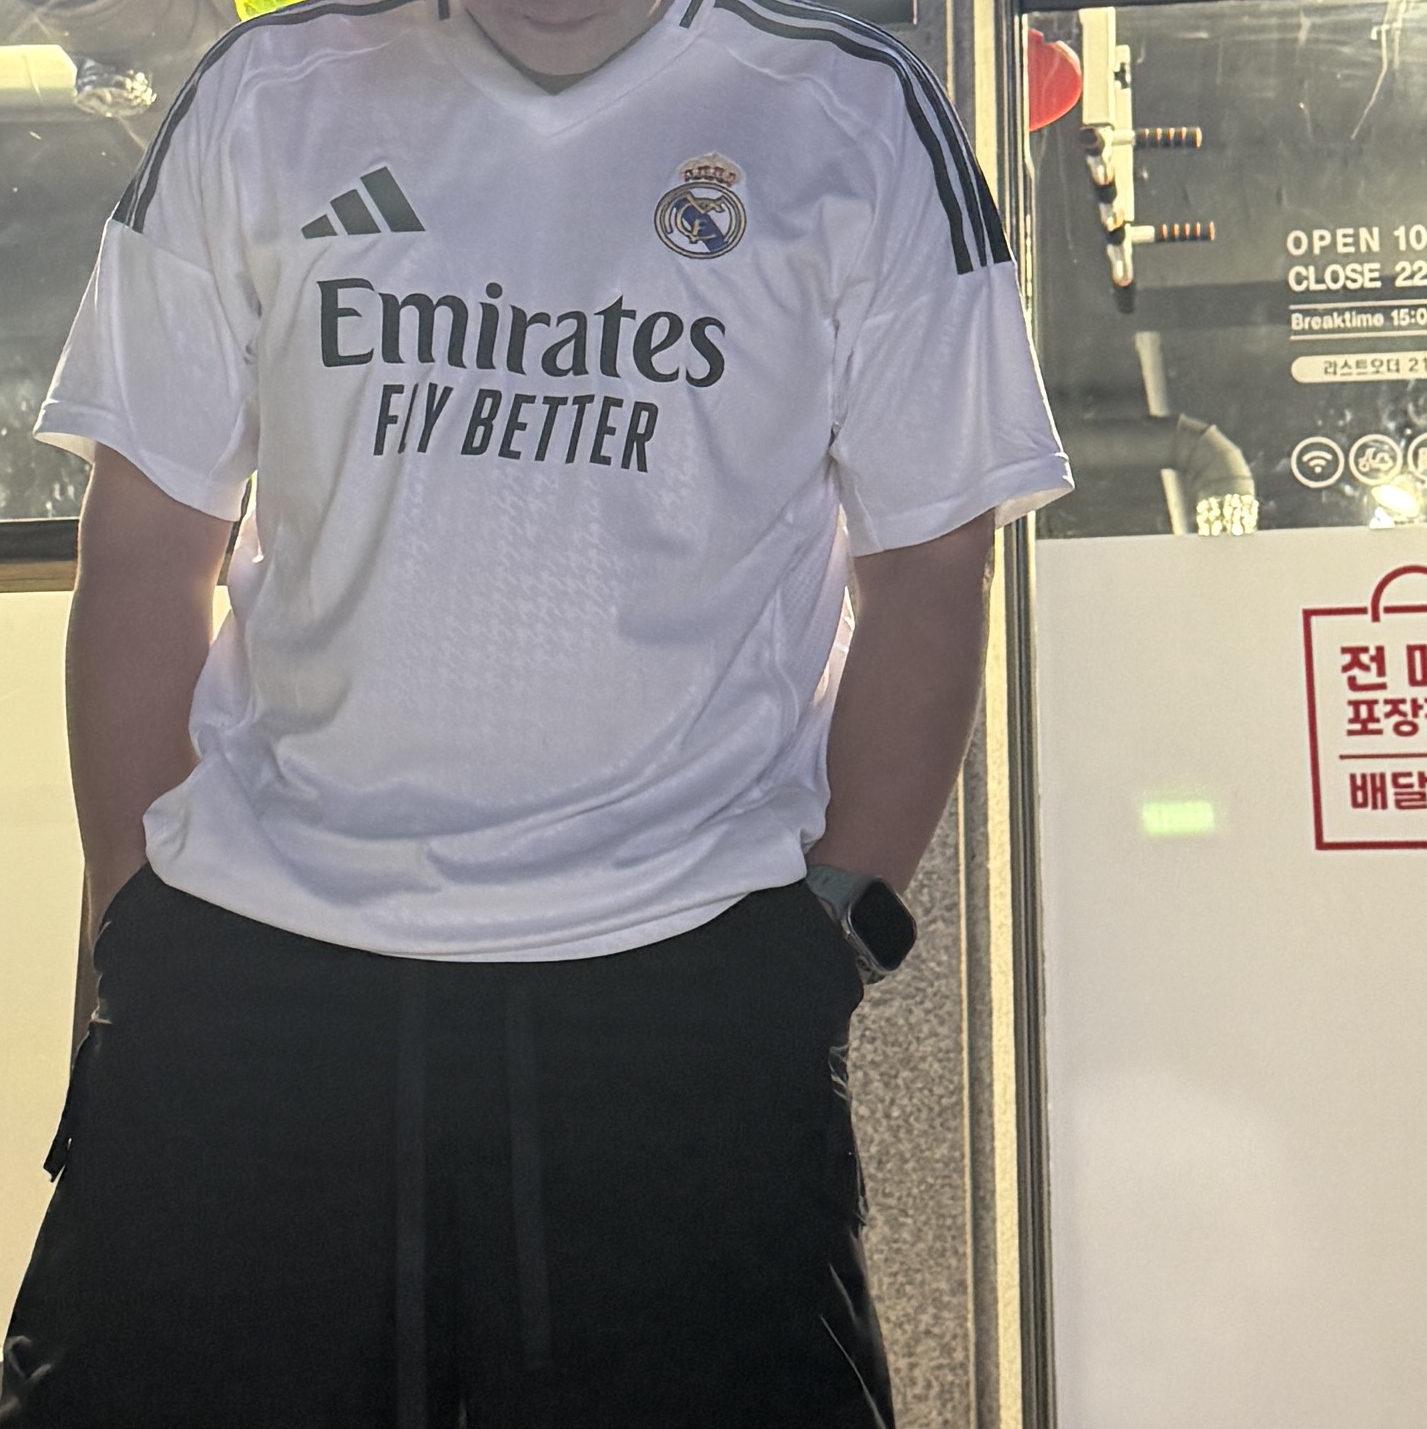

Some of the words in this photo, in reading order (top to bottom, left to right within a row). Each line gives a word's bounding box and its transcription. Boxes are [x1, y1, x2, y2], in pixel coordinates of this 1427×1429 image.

[1286, 226, 1381, 257] OPEN
[1287, 262, 1382, 292] CLOSE
[316, 277, 727, 388] Emirates
[1290, 309, 1385, 331] Breaktime
[1323, 357, 1401, 377] 라스트오더
[460, 389, 659, 473] BETTER
[1340, 645, 1388, 693] 전
